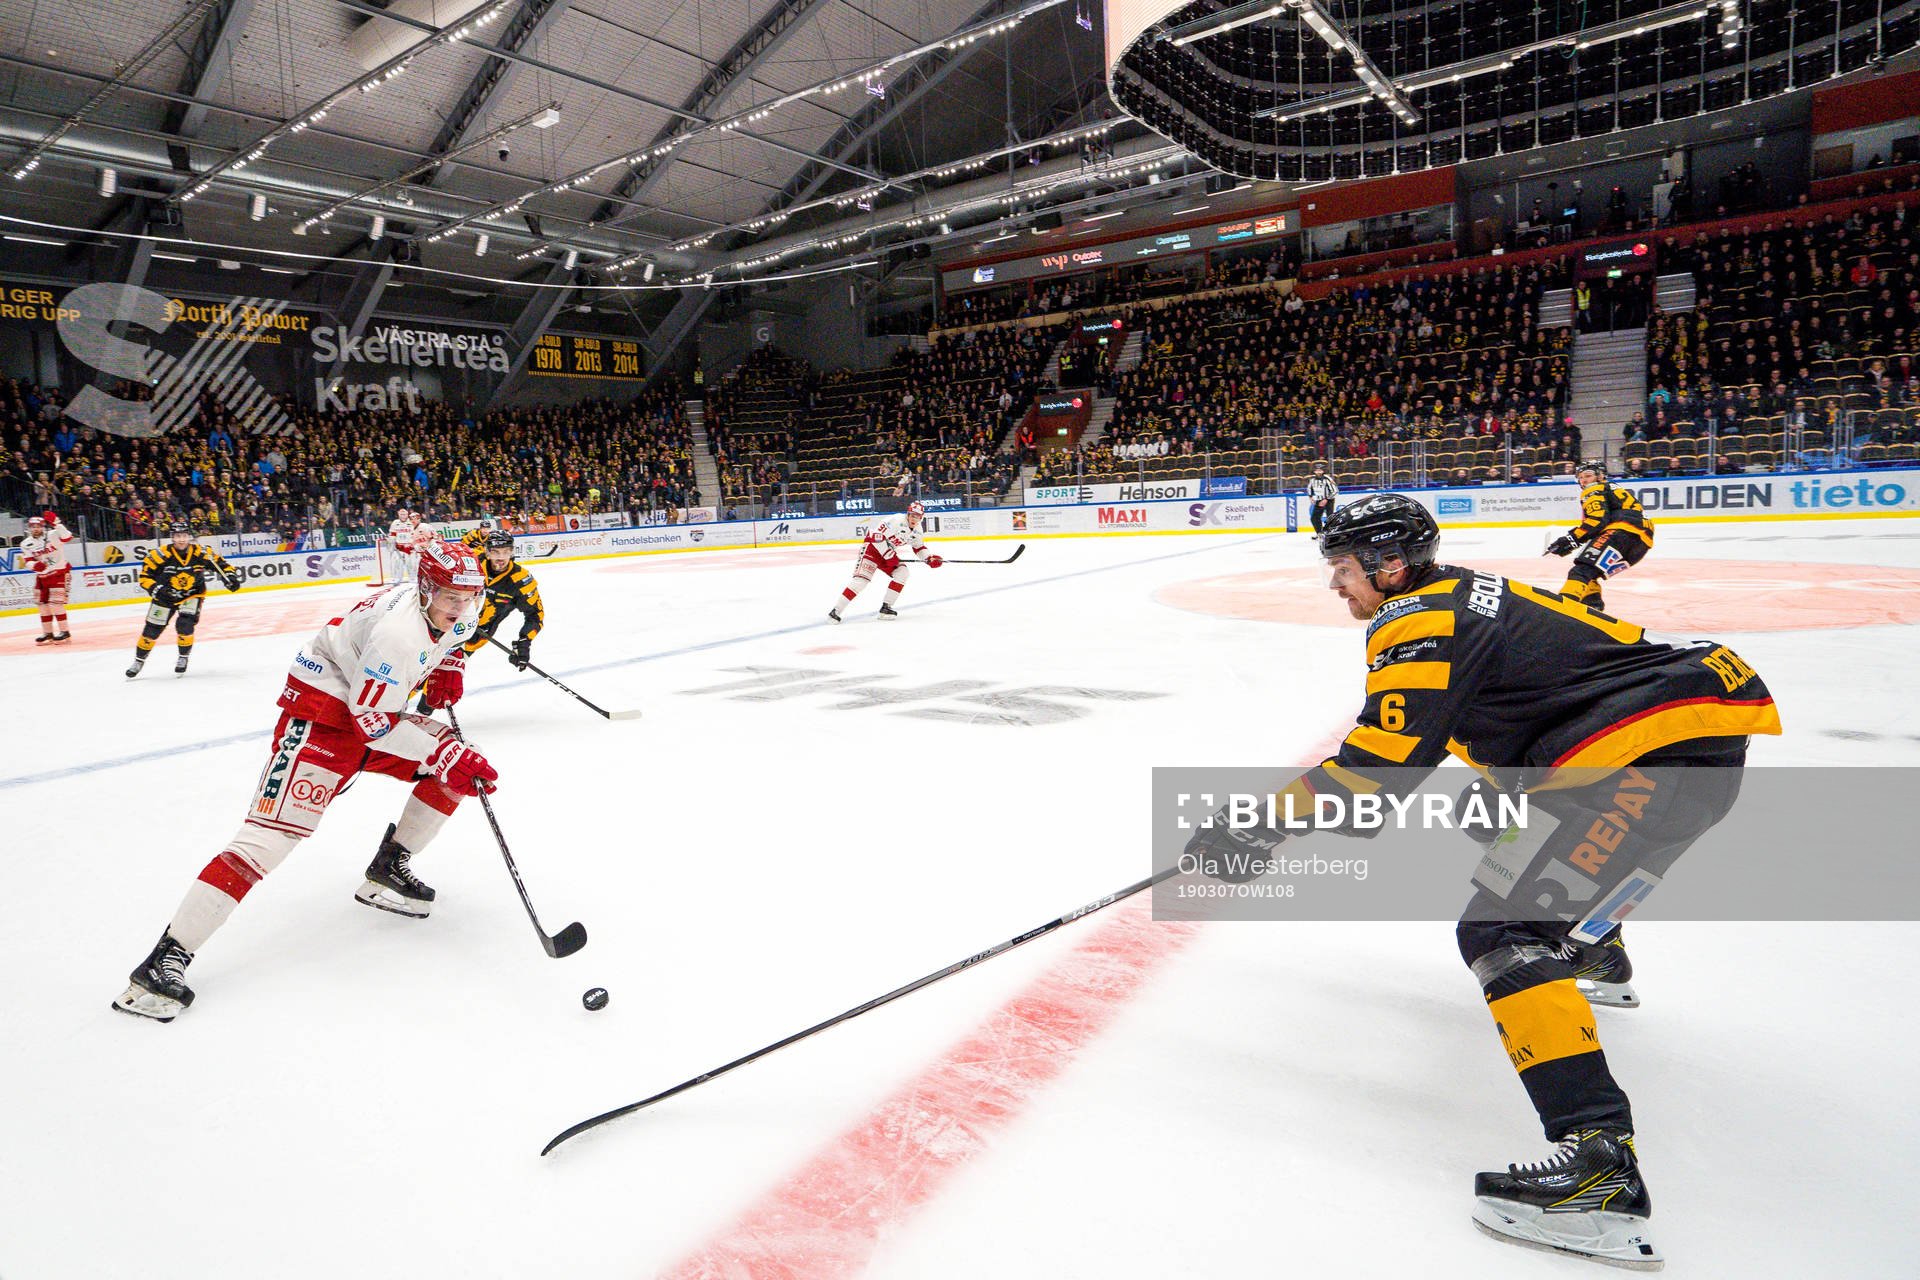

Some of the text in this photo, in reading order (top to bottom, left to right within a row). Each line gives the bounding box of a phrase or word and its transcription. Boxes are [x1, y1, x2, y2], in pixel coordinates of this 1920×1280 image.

[11, 289, 54, 305] GER
[42, 306, 81, 322] UPP
[375, 325, 452, 349] VÄSTRA
[534, 347, 562, 370] 1978
[574, 350, 603, 372] 2013
[613, 354, 639, 375] 2014
[315, 376, 422, 414] Kraft
[1036, 487, 1077, 499] SPORT
[1119, 485, 1187, 500] Henson
[1098, 507, 1147, 524] MAXI
[611, 534, 682, 546] Handelsbanken
[356, 678, 388, 708] 11
[1379, 693, 1406, 731] 6
[434, 744, 462, 777] AUER
